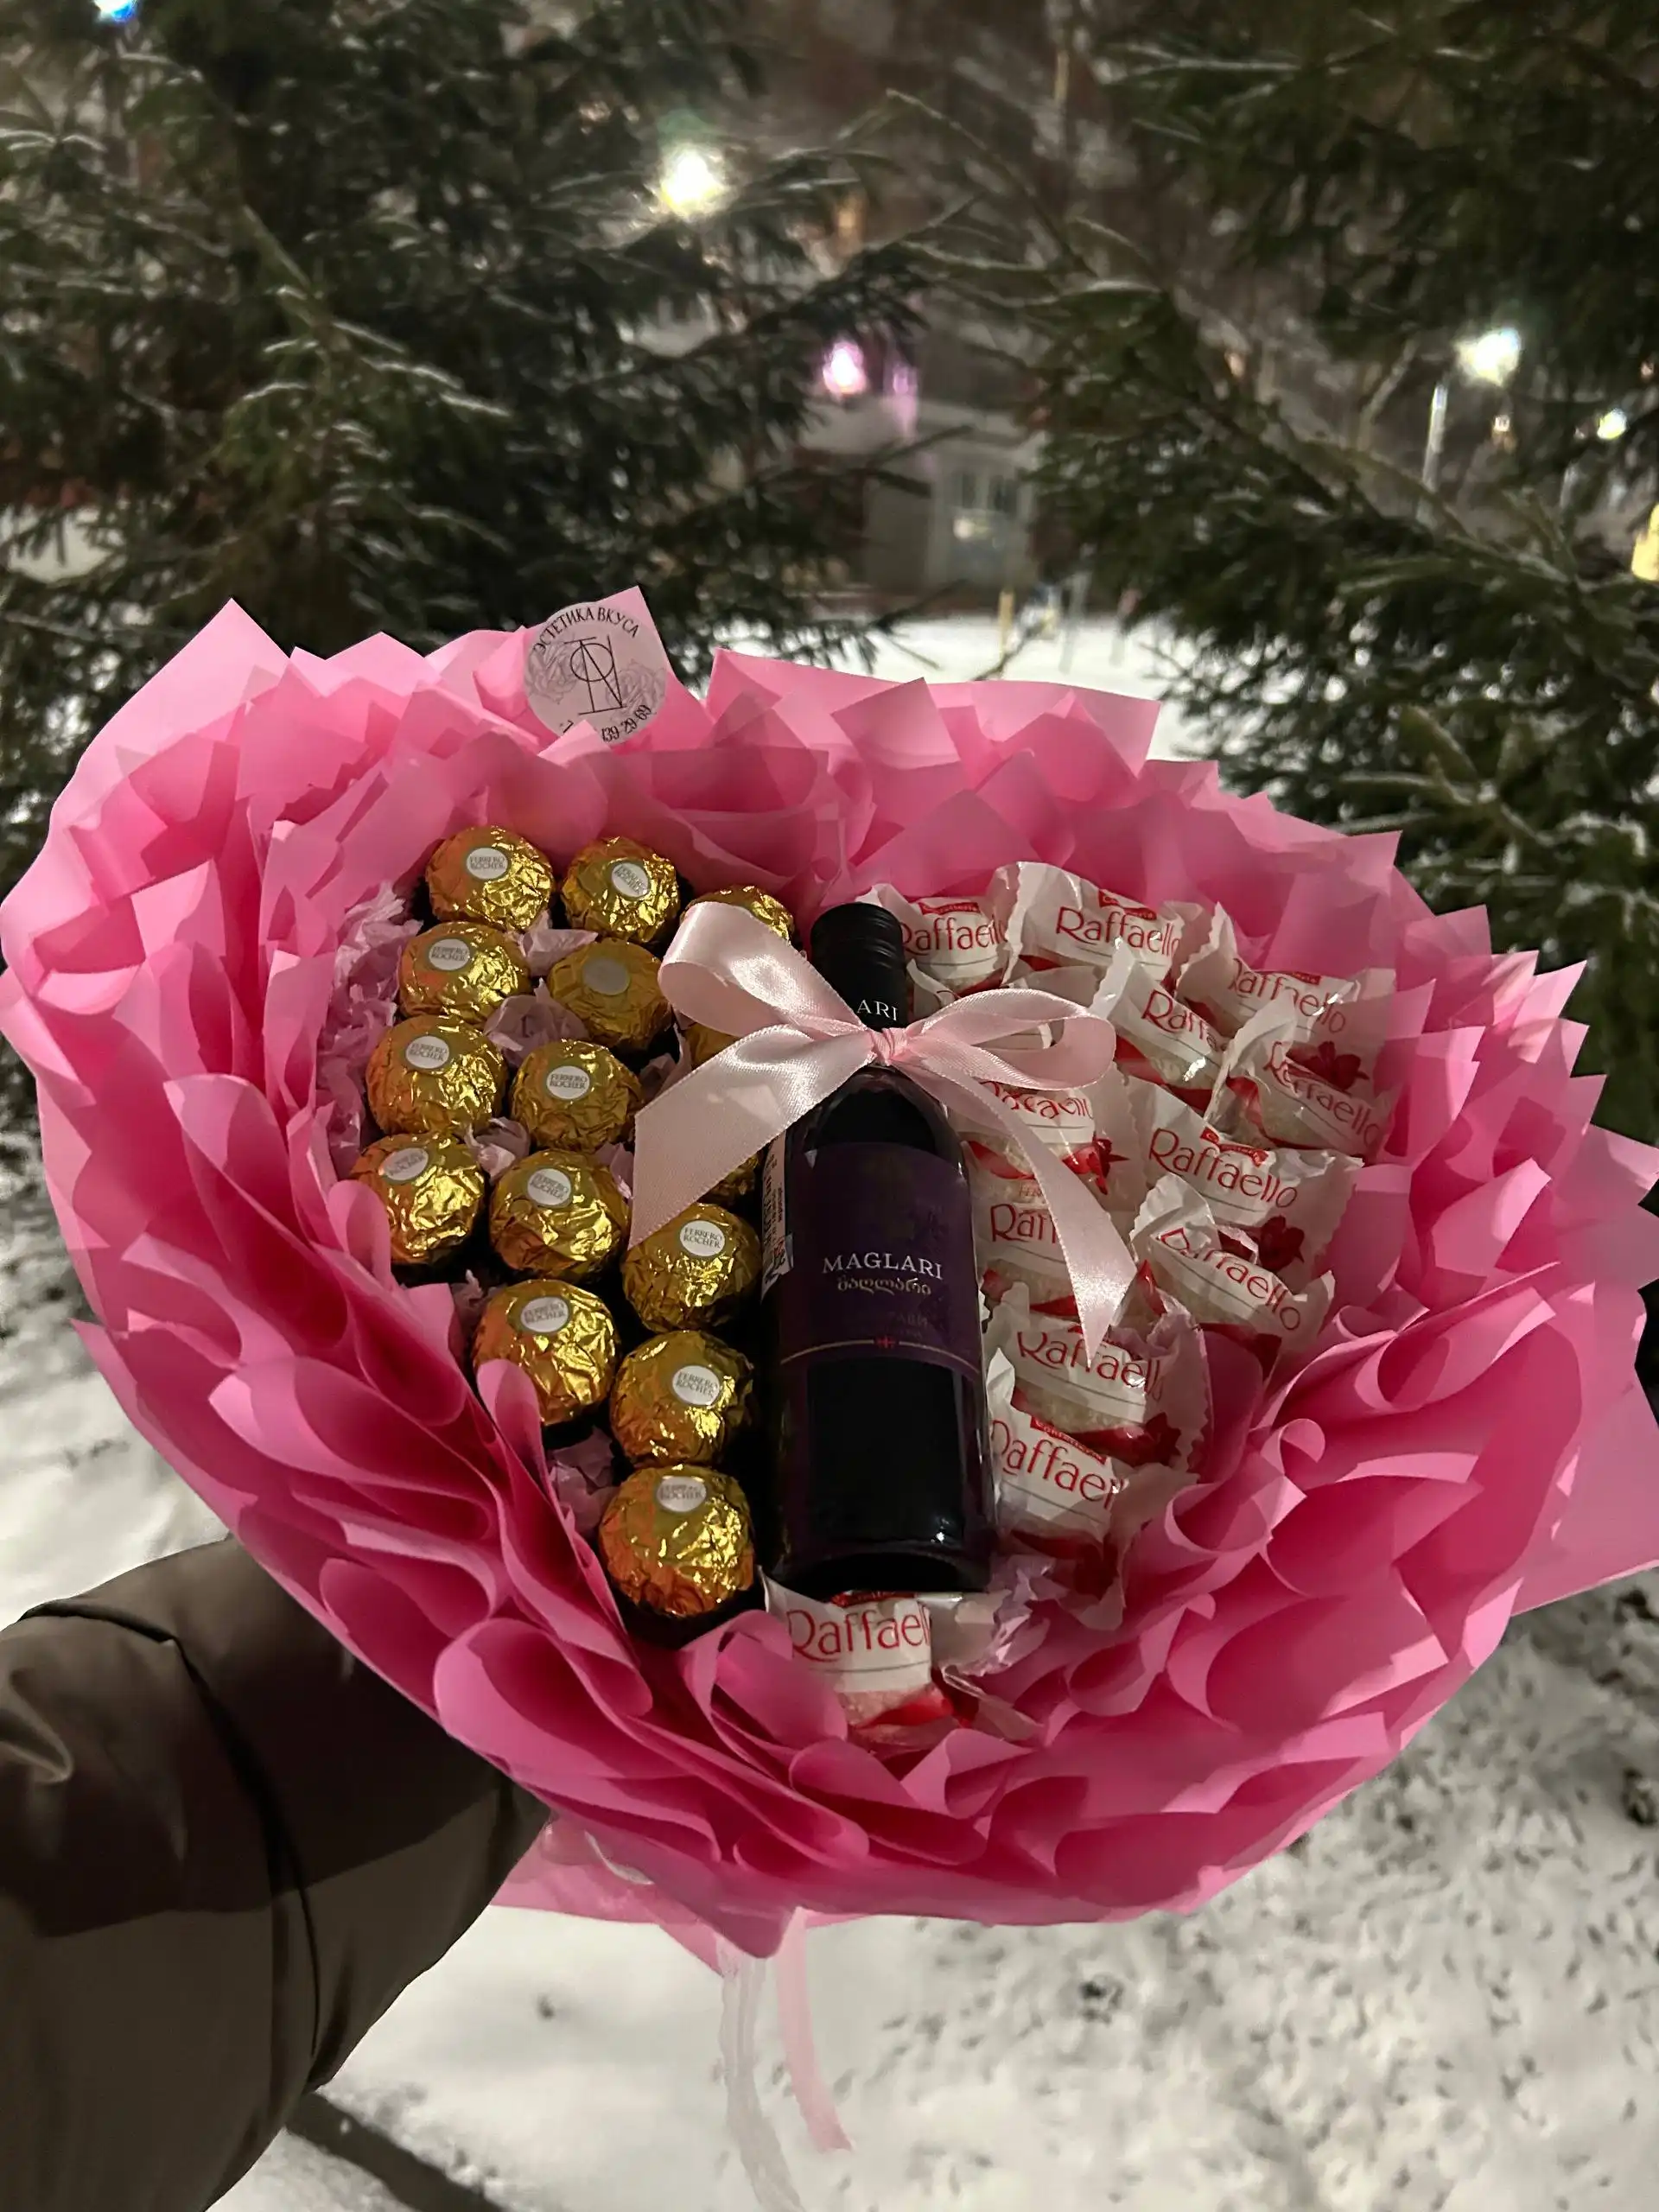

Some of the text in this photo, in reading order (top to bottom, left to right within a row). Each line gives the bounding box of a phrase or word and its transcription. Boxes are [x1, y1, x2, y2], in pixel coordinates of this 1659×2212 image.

[532, 607, 639, 655] ЭСТЕТИКА ВКУСА
[1148, 1128, 1299, 1209] Raffaello
[683, 1234, 721, 1249] ROCHER
[823, 1252, 944, 1280] MAGLARI
